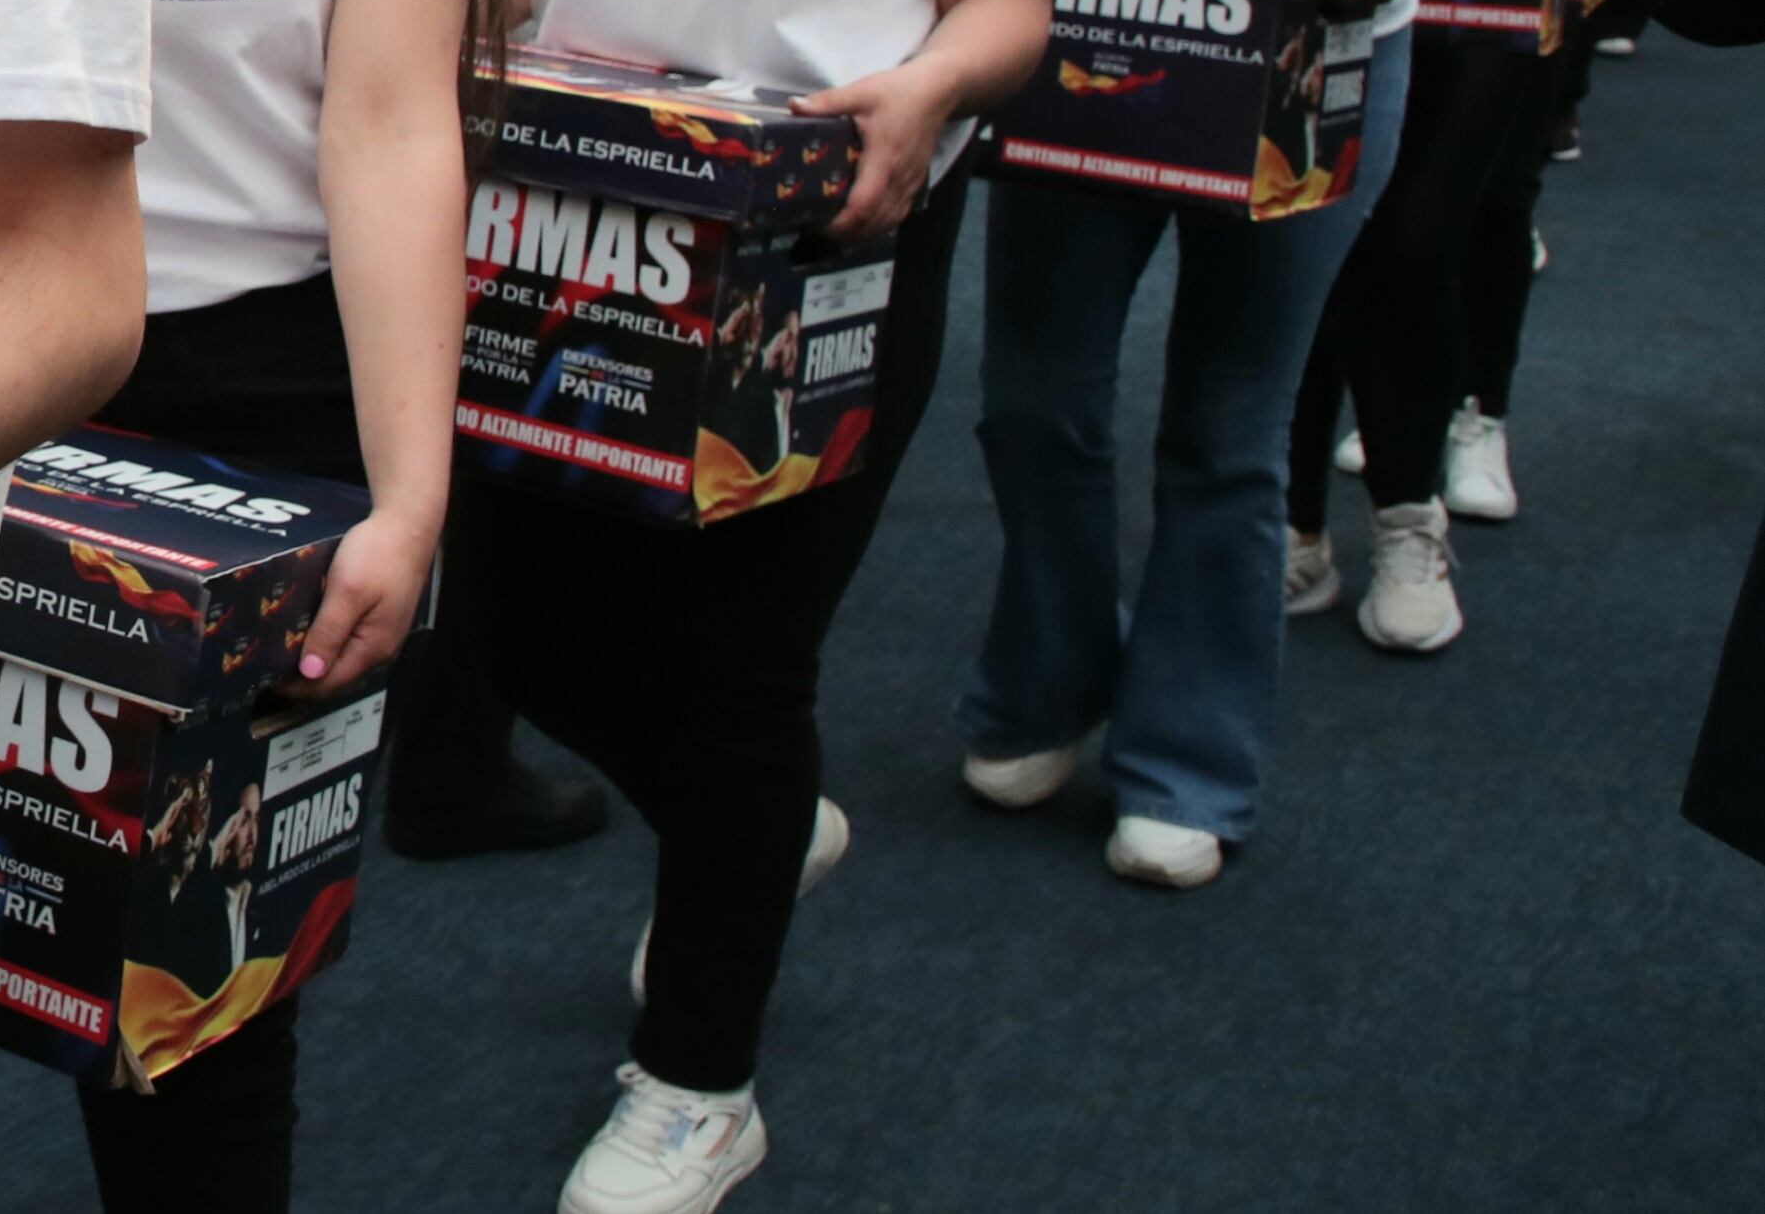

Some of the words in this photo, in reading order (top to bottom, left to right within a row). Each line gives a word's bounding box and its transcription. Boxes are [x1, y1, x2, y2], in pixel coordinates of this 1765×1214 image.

[1087, 26, 1116, 46] DE
[1118, 32, 1147, 49] LA
[1149, 35, 1265, 66] ESPRIELLA
[502, 122, 536, 145] DE
[540, 130, 571, 153] LA
[576, 137, 715, 181] ESPRIELLA
[466, 181, 695, 305] RMAS
[465, 324, 538, 358] FIRME
[502, 283, 533, 306] DE
[538, 292, 568, 315] LA
[573, 300, 705, 347] ESPRIELLA
[462, 354, 530, 384] PATRIA
[562, 348, 653, 381] DEFENSORES
[804, 322, 877, 385] FIRMAS
[558, 373, 647, 415] PATRIA
[480, 412, 573, 455] ALTAMENTE
[574, 435, 685, 485] IMPORTANTE
[23, 441, 311, 524] RMAS
[267, 772, 363, 870] FIRMAS
